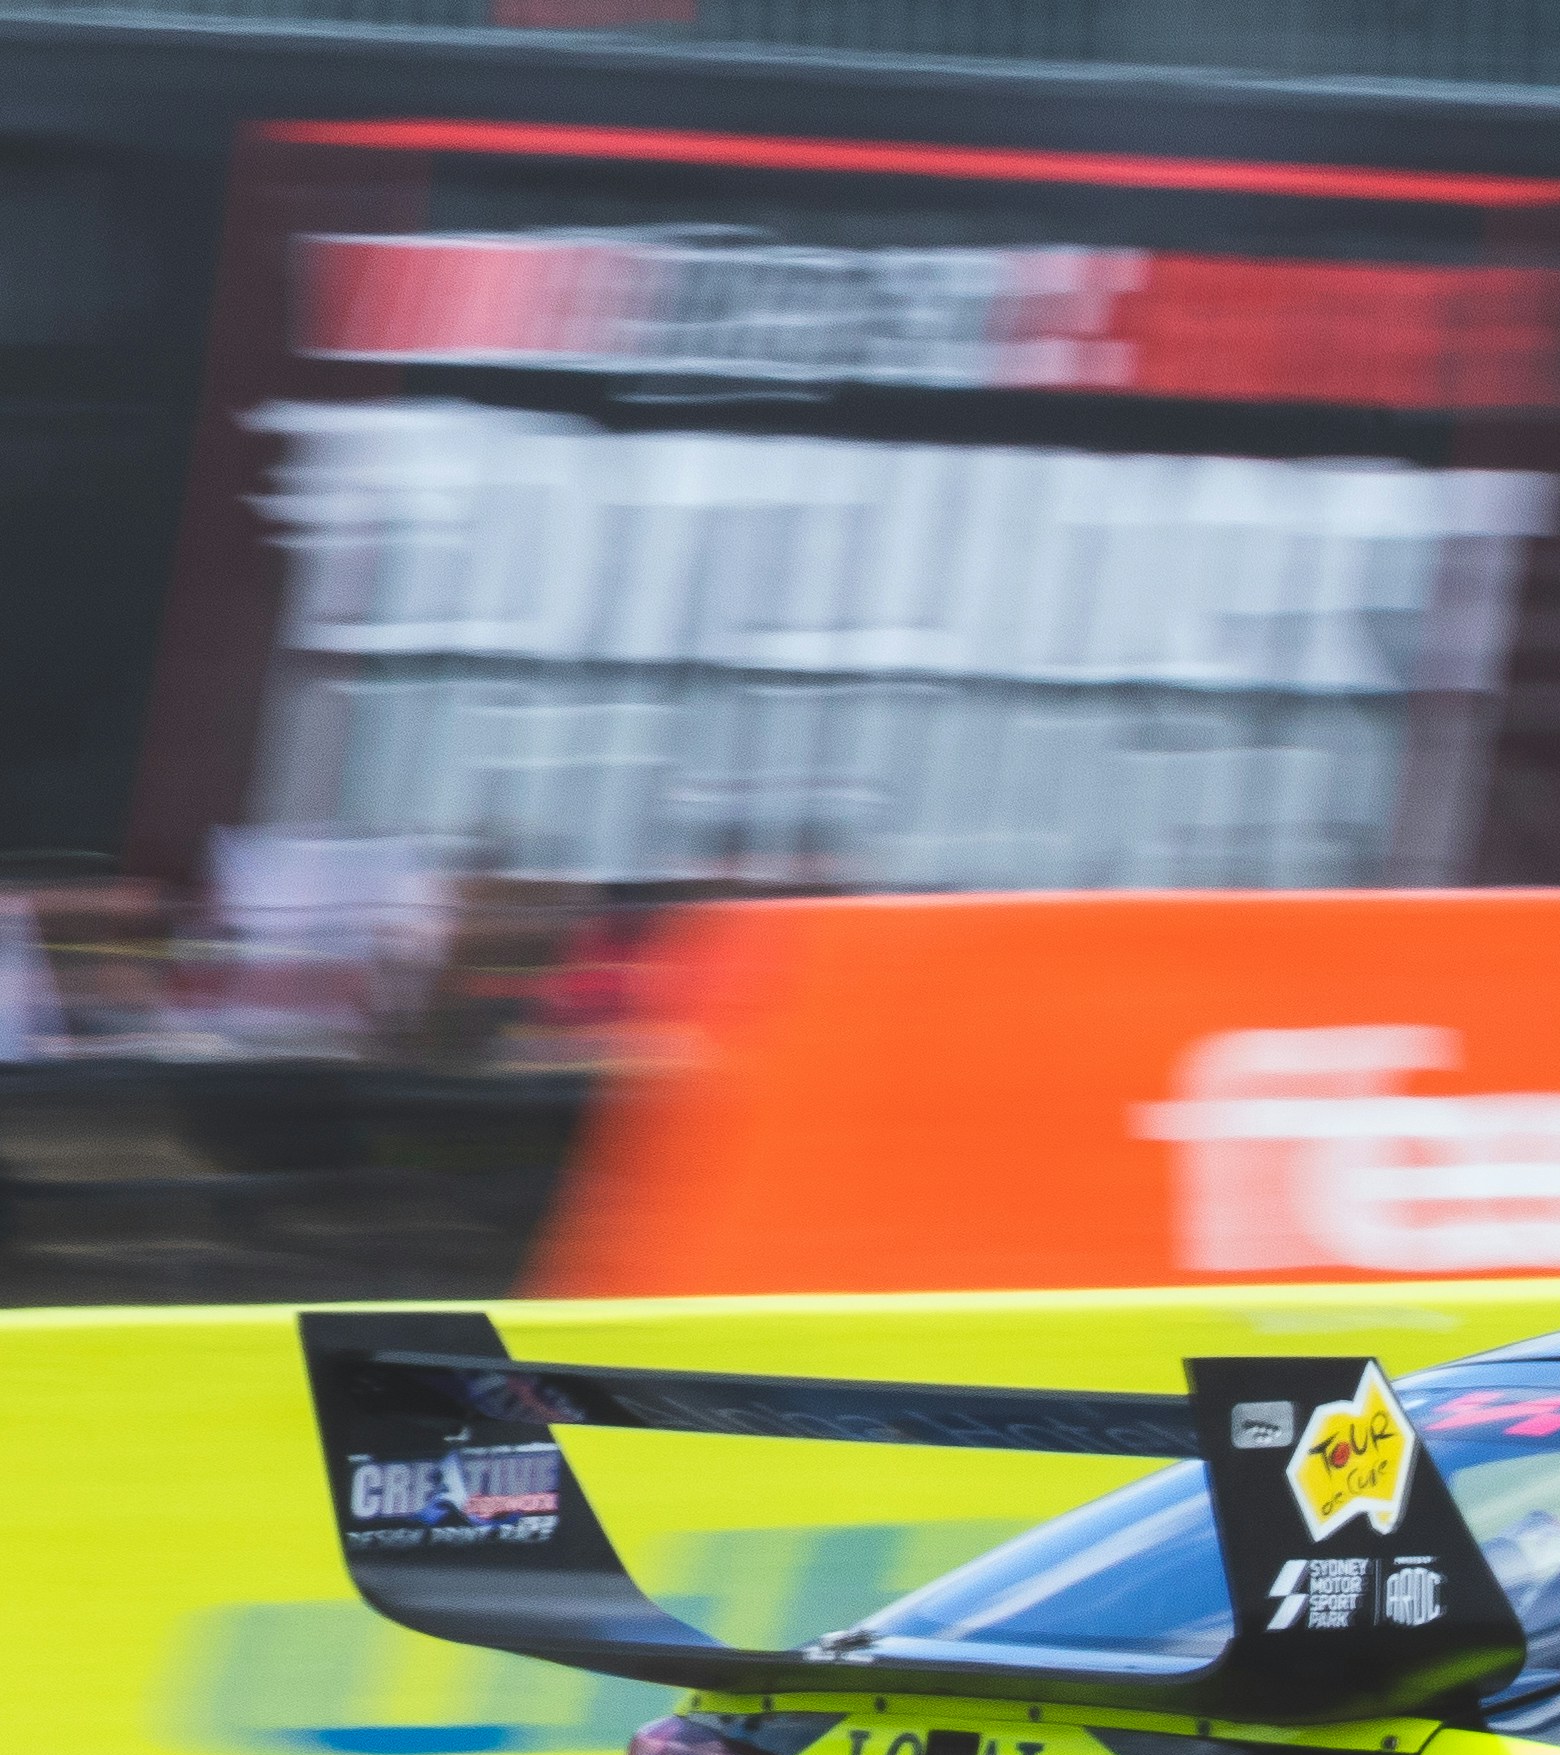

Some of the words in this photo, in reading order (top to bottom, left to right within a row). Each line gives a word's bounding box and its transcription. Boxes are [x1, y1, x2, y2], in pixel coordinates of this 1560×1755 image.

[1309, 1557, 1369, 1577] SYDNEY
[1309, 1577, 1364, 1595] MOTOR
[1309, 1594, 1361, 1612] SPORT
